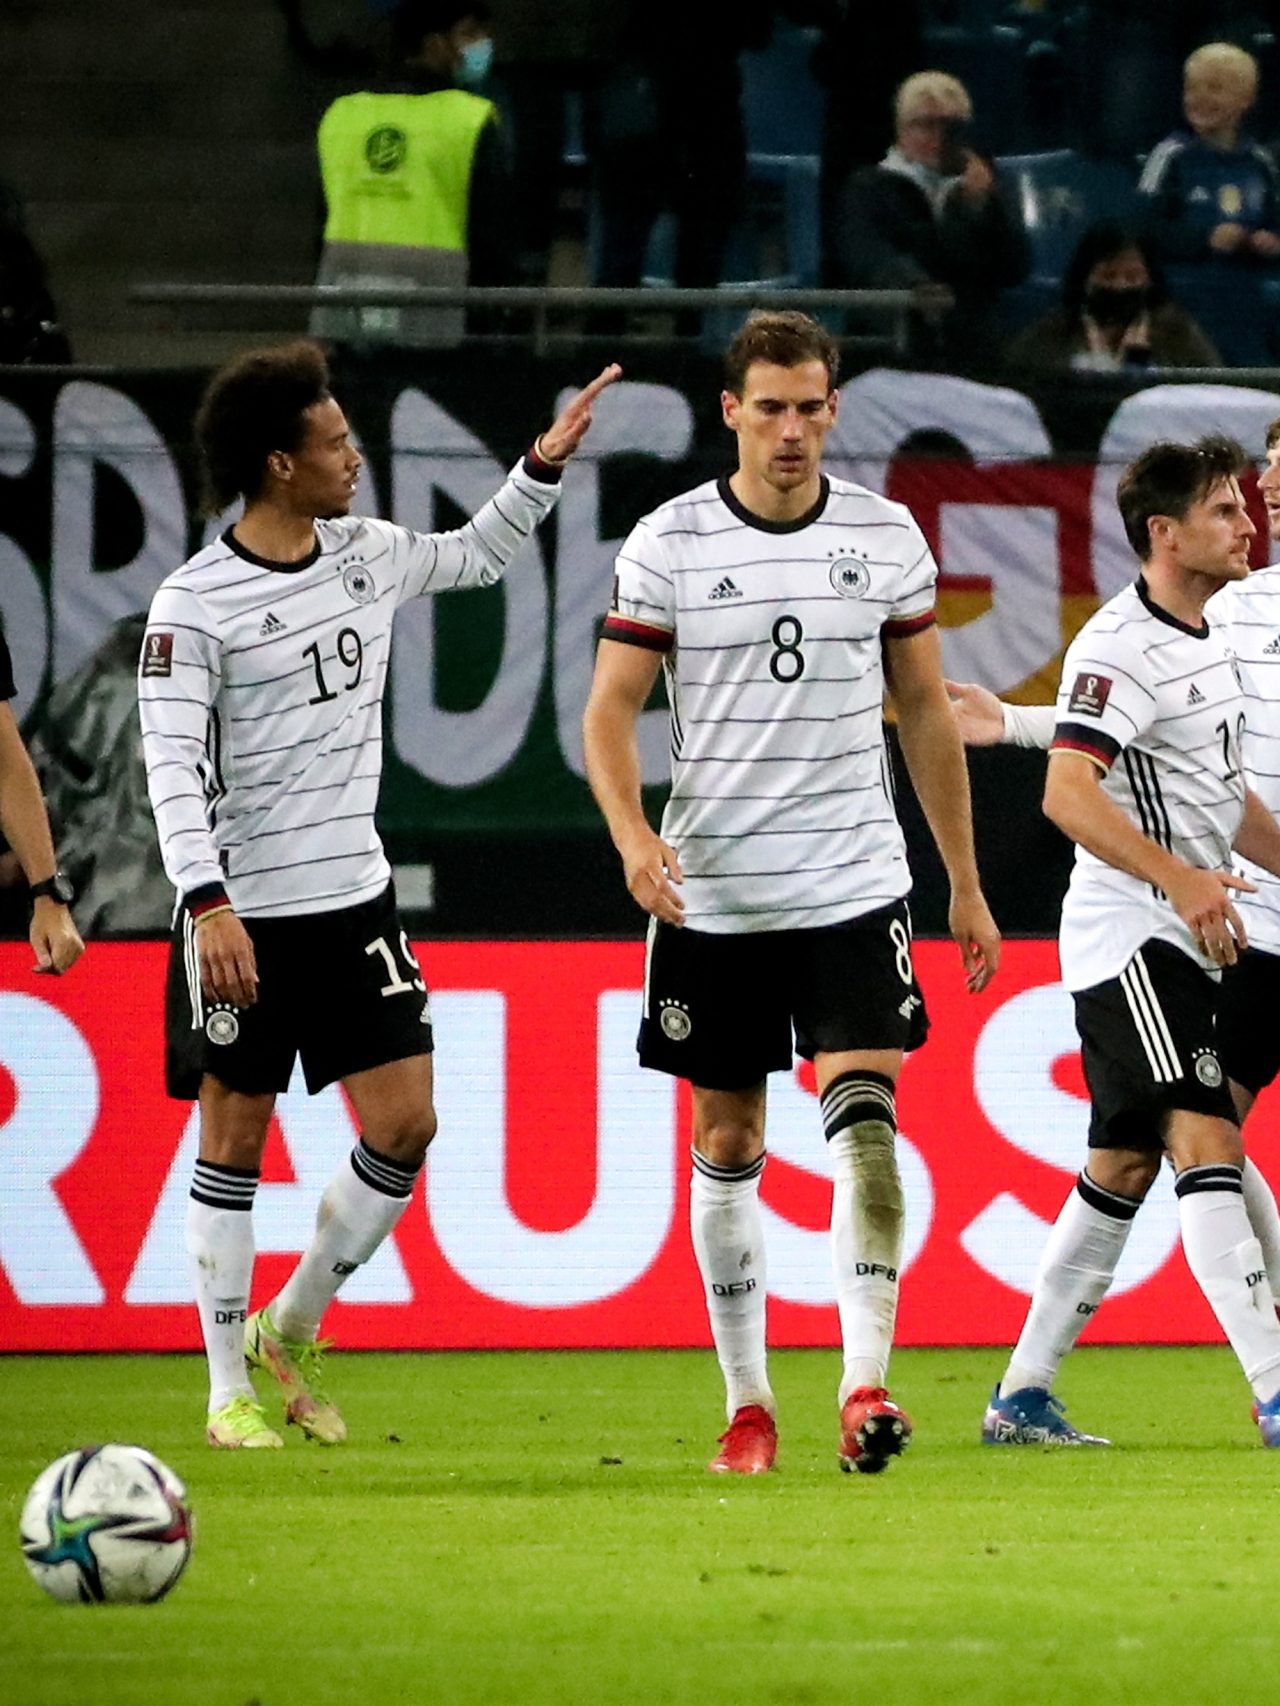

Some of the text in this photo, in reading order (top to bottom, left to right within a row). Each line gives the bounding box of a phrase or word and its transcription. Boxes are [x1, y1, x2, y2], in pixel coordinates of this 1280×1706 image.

[302, 627, 363, 706] 19
[769, 614, 805, 683] 8
[889, 919, 912, 985] 8
[713, 1278, 756, 1297] DFB
[855, 1262, 897, 1282] DFB
